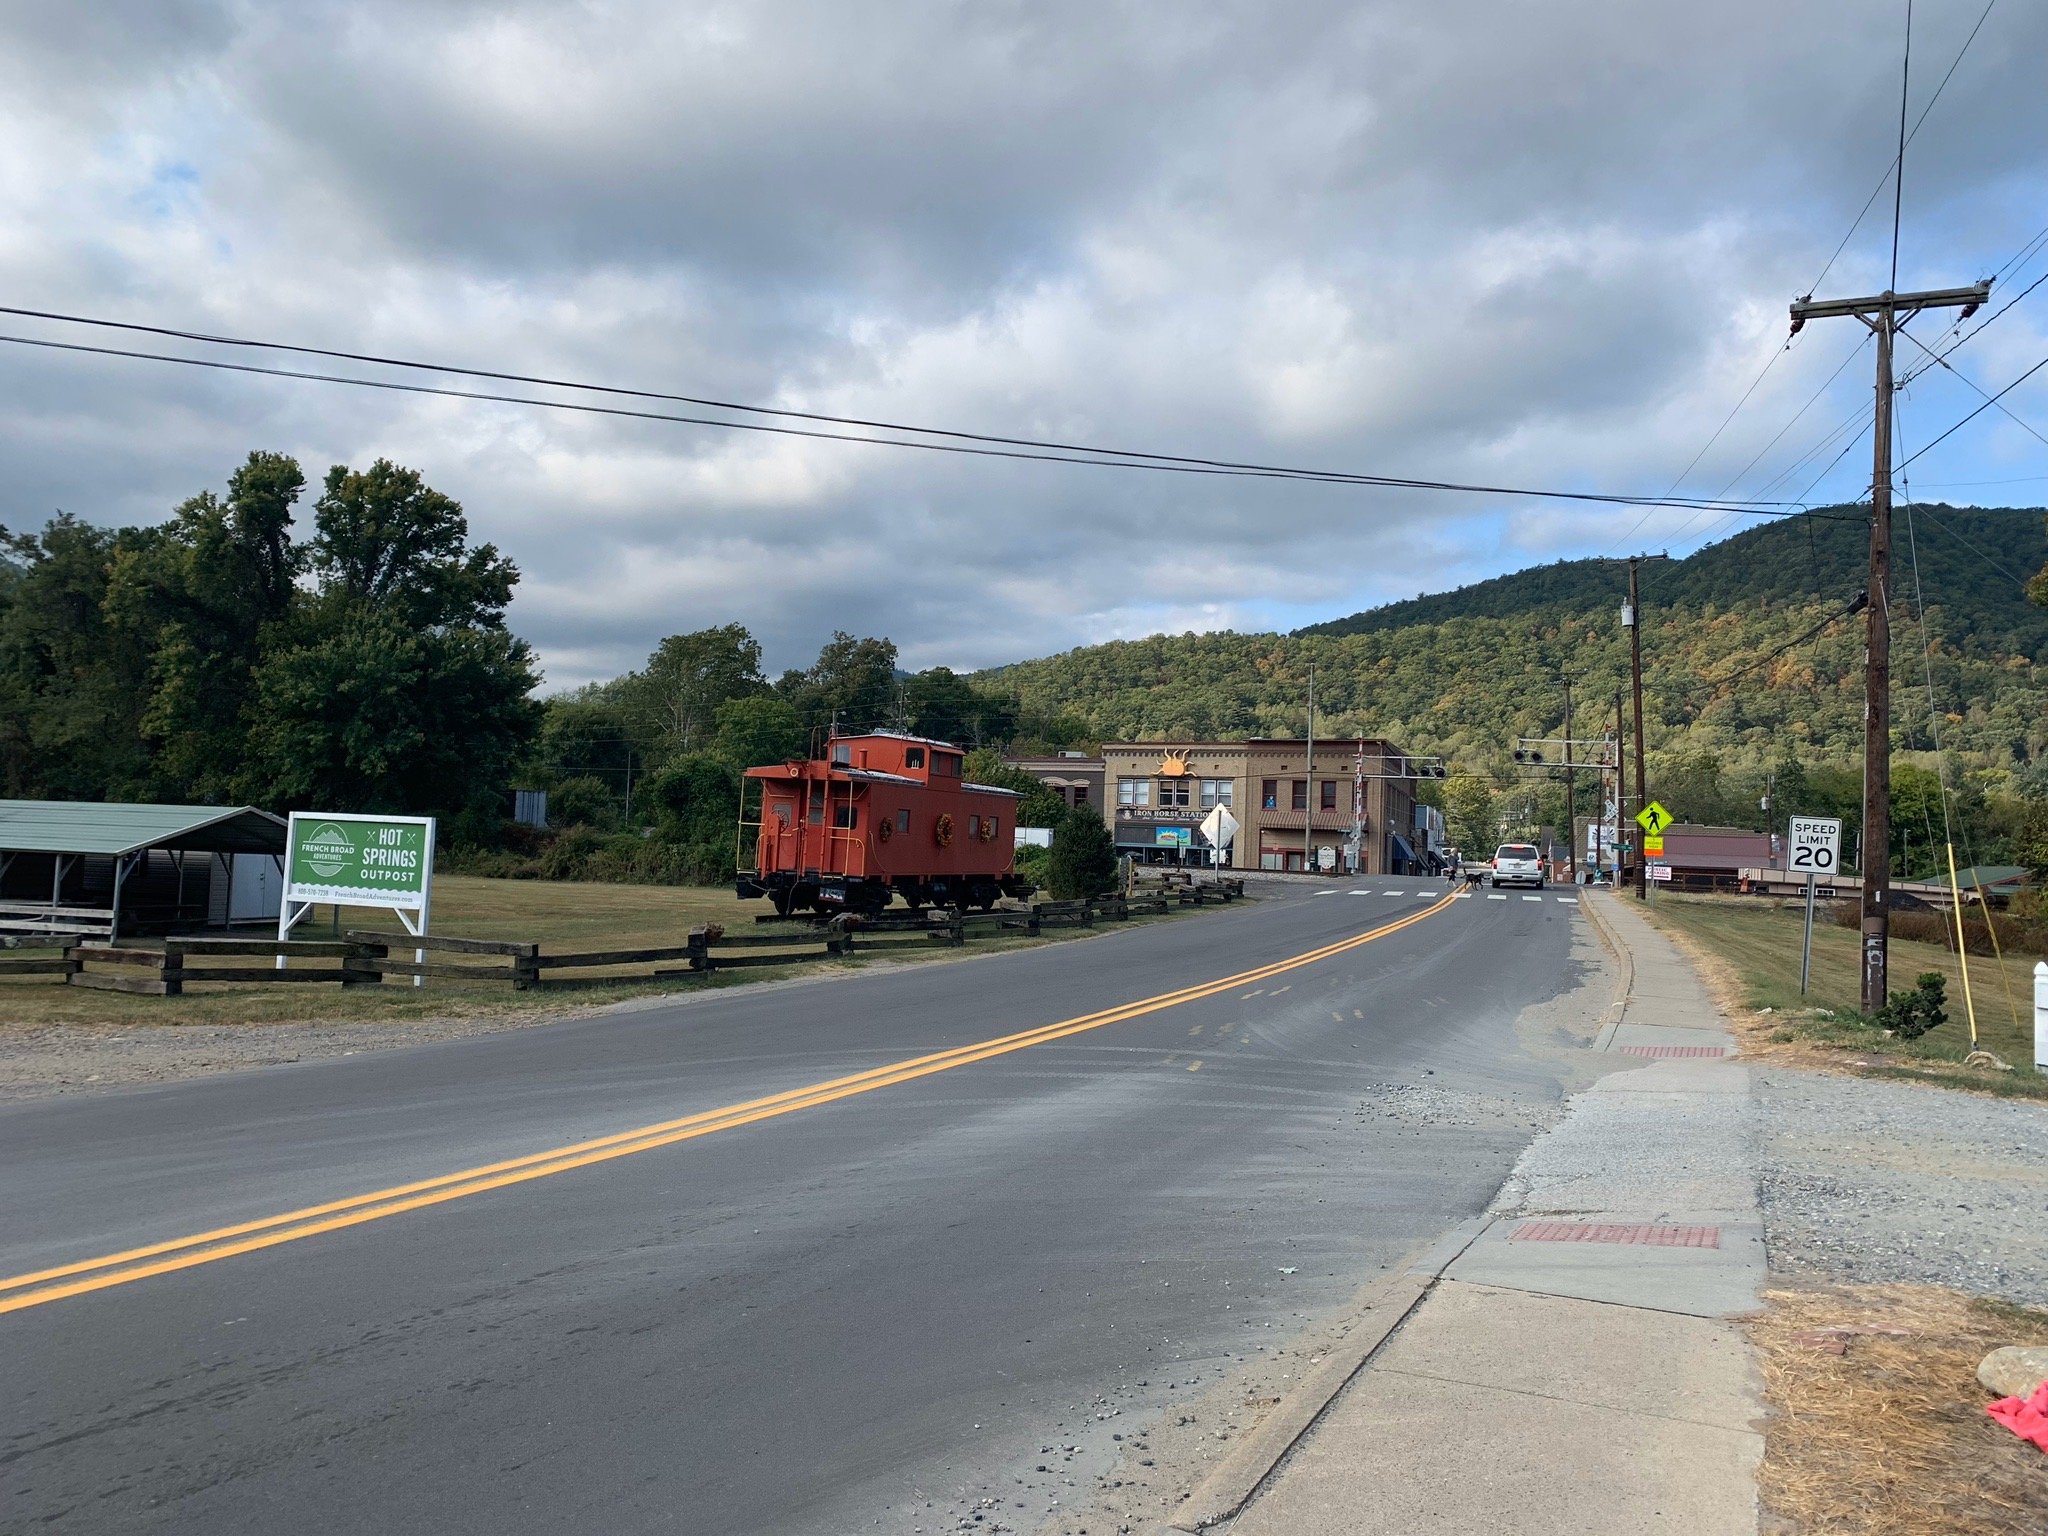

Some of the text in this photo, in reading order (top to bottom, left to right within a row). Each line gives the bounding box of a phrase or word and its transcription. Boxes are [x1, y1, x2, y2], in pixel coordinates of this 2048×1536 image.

[1795, 823, 1837, 834] SPEED
[379, 828, 403, 846] HOT
[1798, 835, 1831, 845] LIMIT
[301, 844, 355, 854] FRENCH BROAD
[313, 853, 342, 861] ADVENTURES
[362, 847, 417, 868] SPRINGS
[1794, 846, 1833, 868] 20
[360, 869, 415, 882] OUTPOST
[334, 891, 413, 903] FrenchBroadAdventures.com
